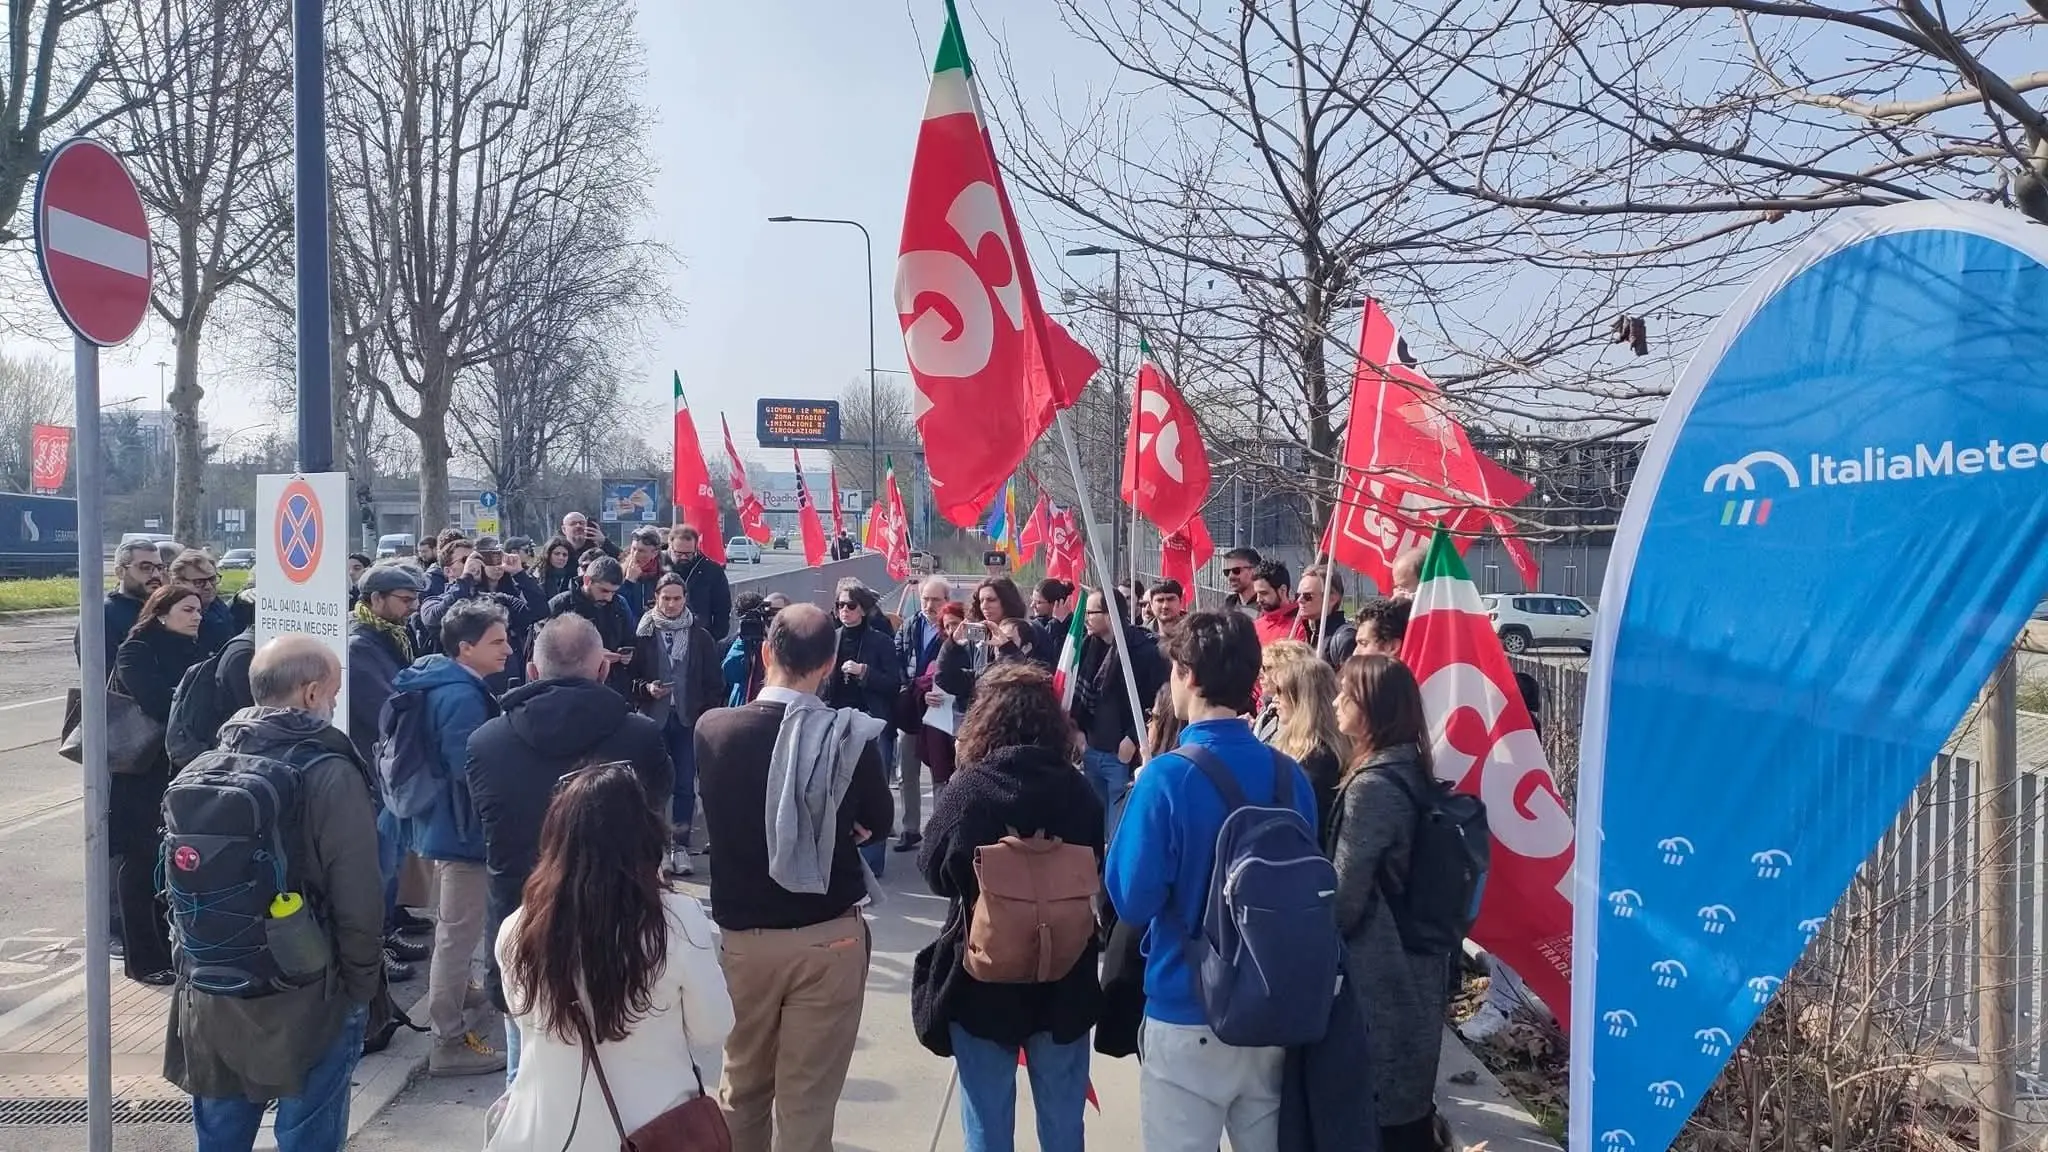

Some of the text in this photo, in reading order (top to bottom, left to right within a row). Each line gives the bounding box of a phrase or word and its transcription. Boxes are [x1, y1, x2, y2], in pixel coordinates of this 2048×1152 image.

[765, 406, 796, 414] GIOVEDI
[765, 420, 813, 428] LIMITAZIONI
[698, 483, 714, 498] BO
[763, 491, 798, 507] Roadho
[261, 597, 339, 617] DAL 04/03 AL 06/03
[261, 617, 339, 636] PER FIERA MECSPE
[1420, 663, 1575, 904] CG
